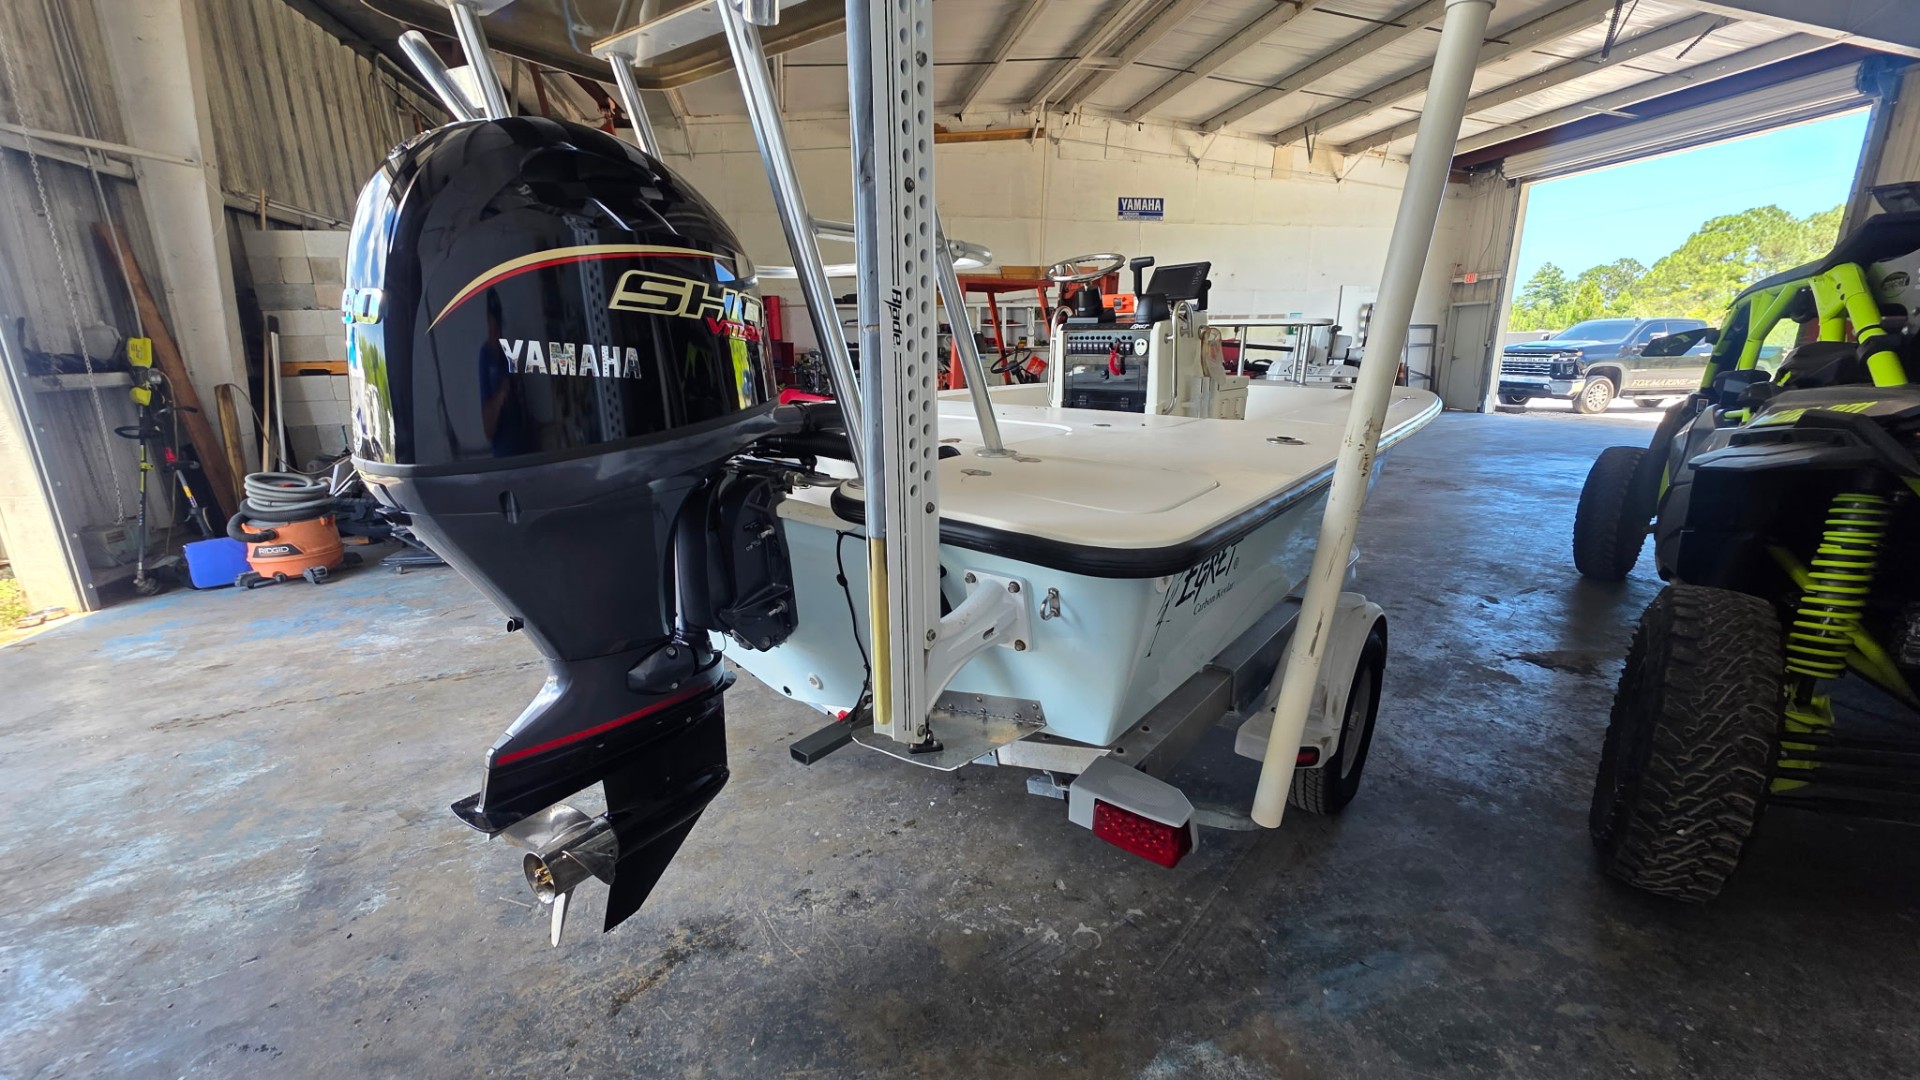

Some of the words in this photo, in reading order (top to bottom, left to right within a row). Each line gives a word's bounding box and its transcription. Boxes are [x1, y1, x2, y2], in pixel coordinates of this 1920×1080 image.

[1121, 199, 1162, 211] YAMAHA
[883, 288, 903, 347] Blade
[498, 338, 642, 380] YAMAHA
[258, 546, 290, 554] RIDGID
